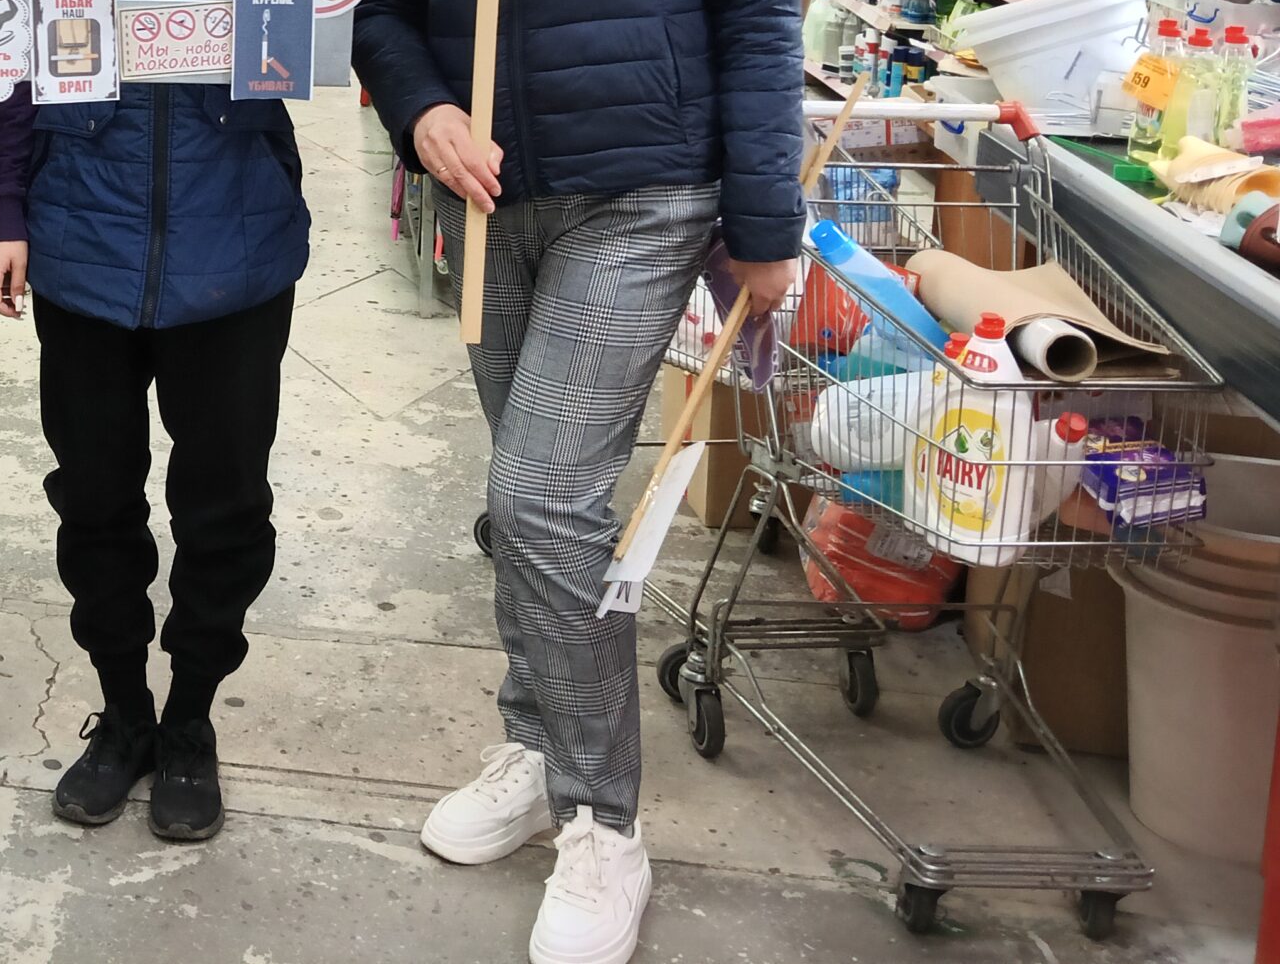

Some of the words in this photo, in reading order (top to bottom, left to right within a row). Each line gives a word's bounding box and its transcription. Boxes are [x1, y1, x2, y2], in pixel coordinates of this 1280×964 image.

[61, 8, 86, 19] НАШ
[138, 43, 169, 58] Мы
[185, 42, 230, 55] новое
[134, 54, 233, 73] поколение
[58, 80, 94, 94] ВРАГ!
[248, 79, 296, 93] УБИВАЕТ
[1130, 71, 1151, 89] 159
